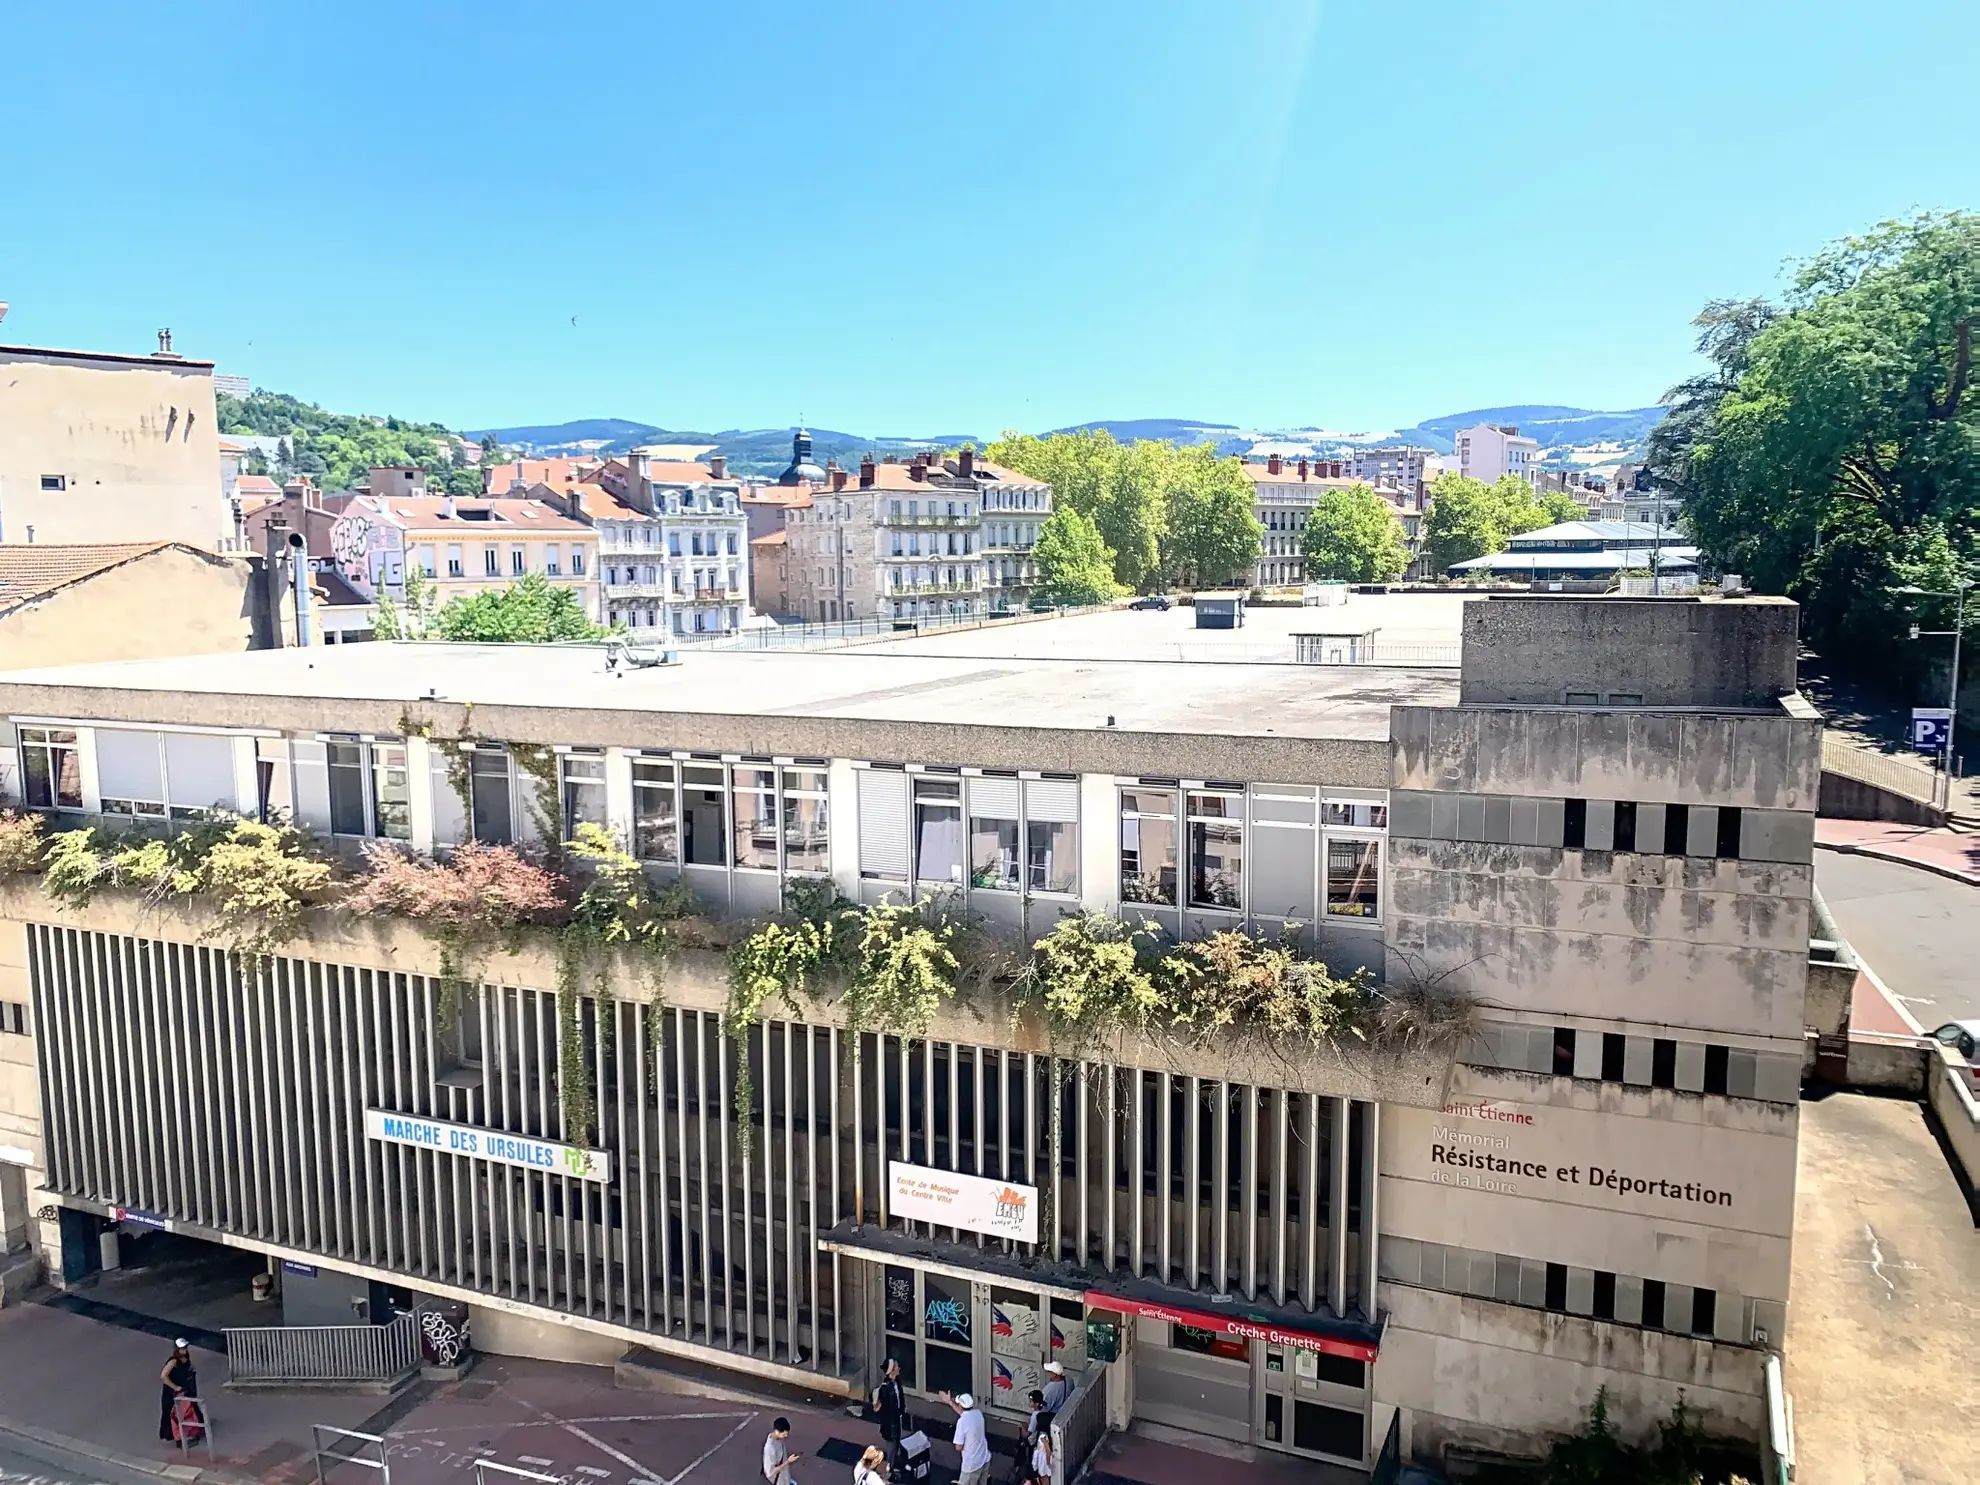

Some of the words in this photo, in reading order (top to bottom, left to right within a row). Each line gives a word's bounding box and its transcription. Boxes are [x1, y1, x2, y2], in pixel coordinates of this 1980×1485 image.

[1915, 721, 1936, 742] P
[383, 1117, 442, 1146] MARCHE
[450, 1129, 478, 1153] DES
[487, 1136, 554, 1168] URSULES
[1432, 1125, 1511, 1149] Mémorial
[1431, 1144, 1548, 1179] Résistance
[1556, 1165, 1580, 1184] et
[1589, 1166, 1733, 1207] Déportation
[1431, 1169, 1450, 1184] de
[1456, 1172, 1470, 1187] la
[1476, 1175, 1518, 1193] Loire
[898, 1187, 909, 1195] du
[911, 1189, 934, 1200] Centre
[930, 1183, 960, 1196] Musique
[1227, 1322, 1267, 1340] Crèche
[1270, 1331, 1322, 1352] Grenette
